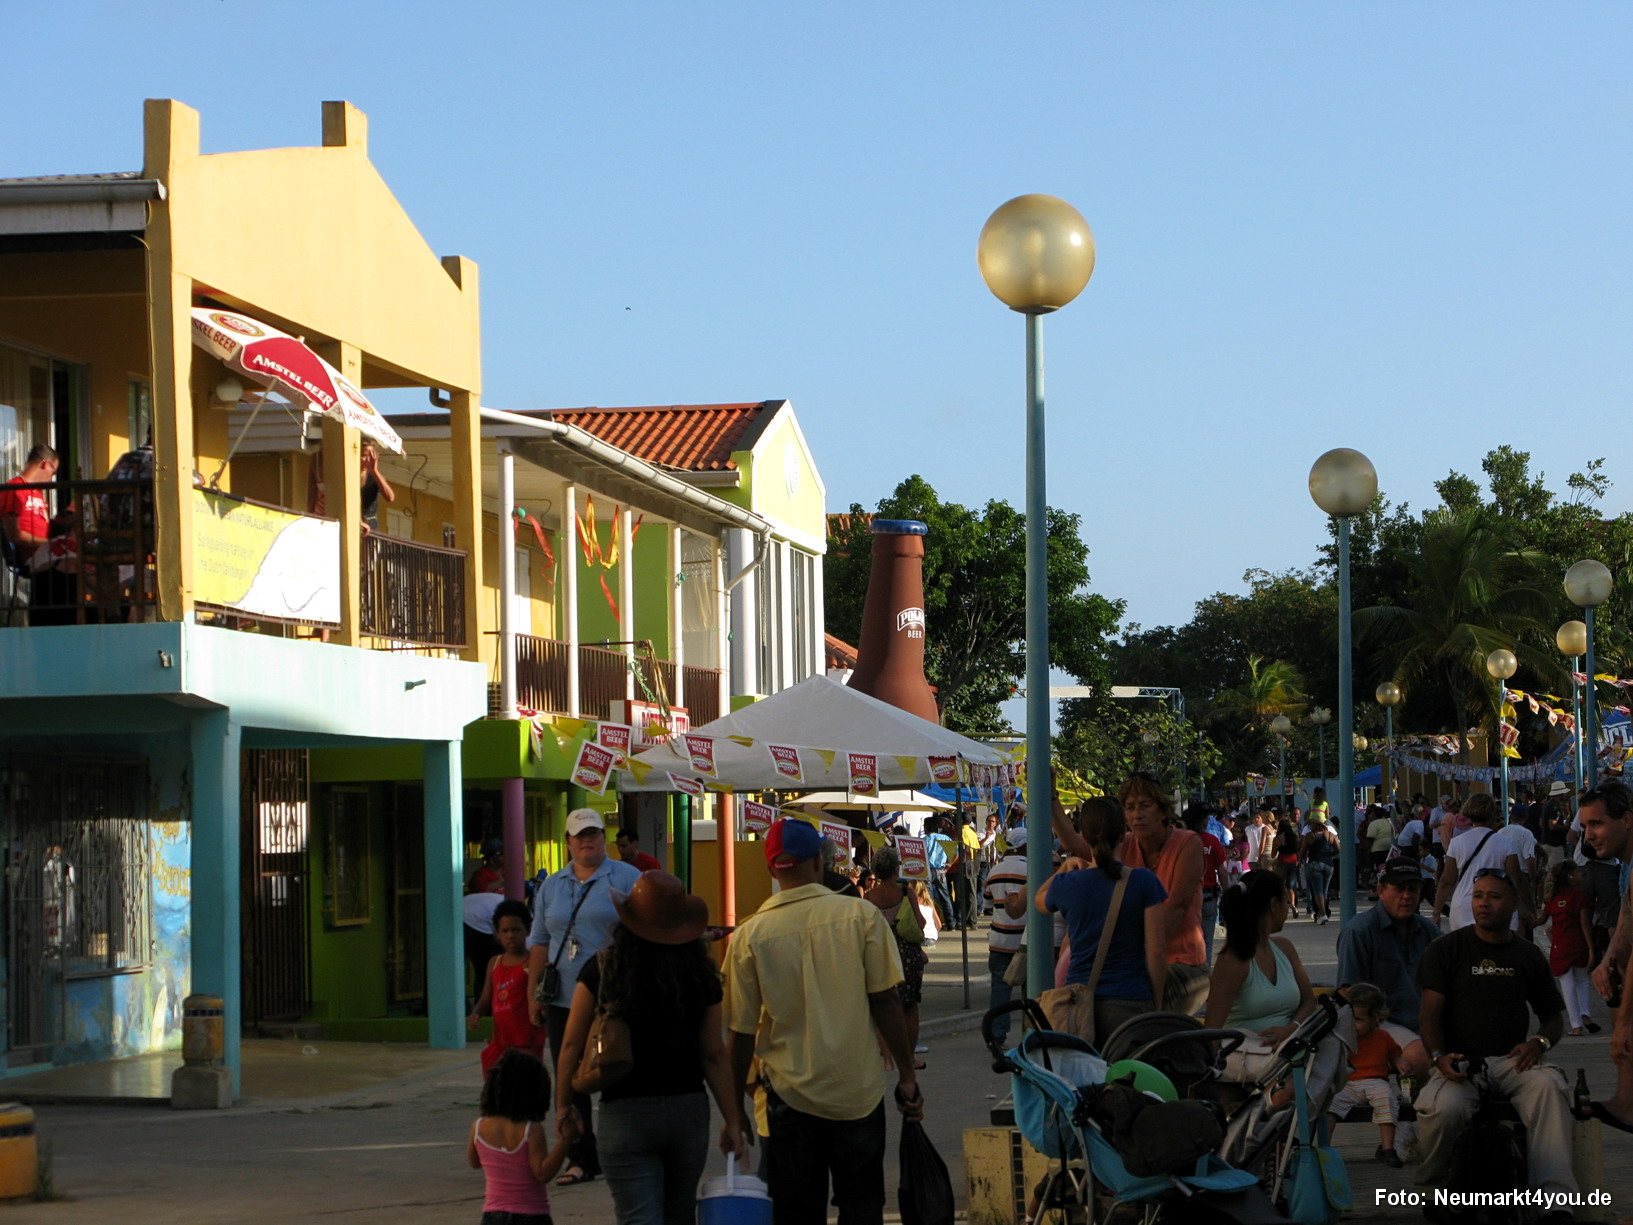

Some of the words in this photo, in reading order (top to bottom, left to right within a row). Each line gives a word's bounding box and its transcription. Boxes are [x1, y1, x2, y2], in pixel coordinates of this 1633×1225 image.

[213, 331, 237, 353] BEER
[252, 354, 303, 385] AMSTEL
[303, 380, 334, 407] BEER
[907, 630, 923, 639] BEER
[601, 728, 629, 738] AMSTEL
[606, 735, 624, 744] BEER
[687, 738, 712, 749] AMSTEL
[584, 746, 611, 763] AMSTEL
[692, 746, 708, 754] BEER
[771, 746, 796, 757] AMSTEL
[777, 752, 794, 760] BEER
[850, 756, 876, 765] AMSTEL
[587, 755, 605, 768] BEER
[855, 763, 872, 771] BEER
[745, 803, 771, 817] AMSTEL
[750, 810, 768, 820] BEER
[823, 826, 848, 838] AMSTEL
[900, 840, 924, 850] AMSTEL
[905, 847, 921, 855] BEER
